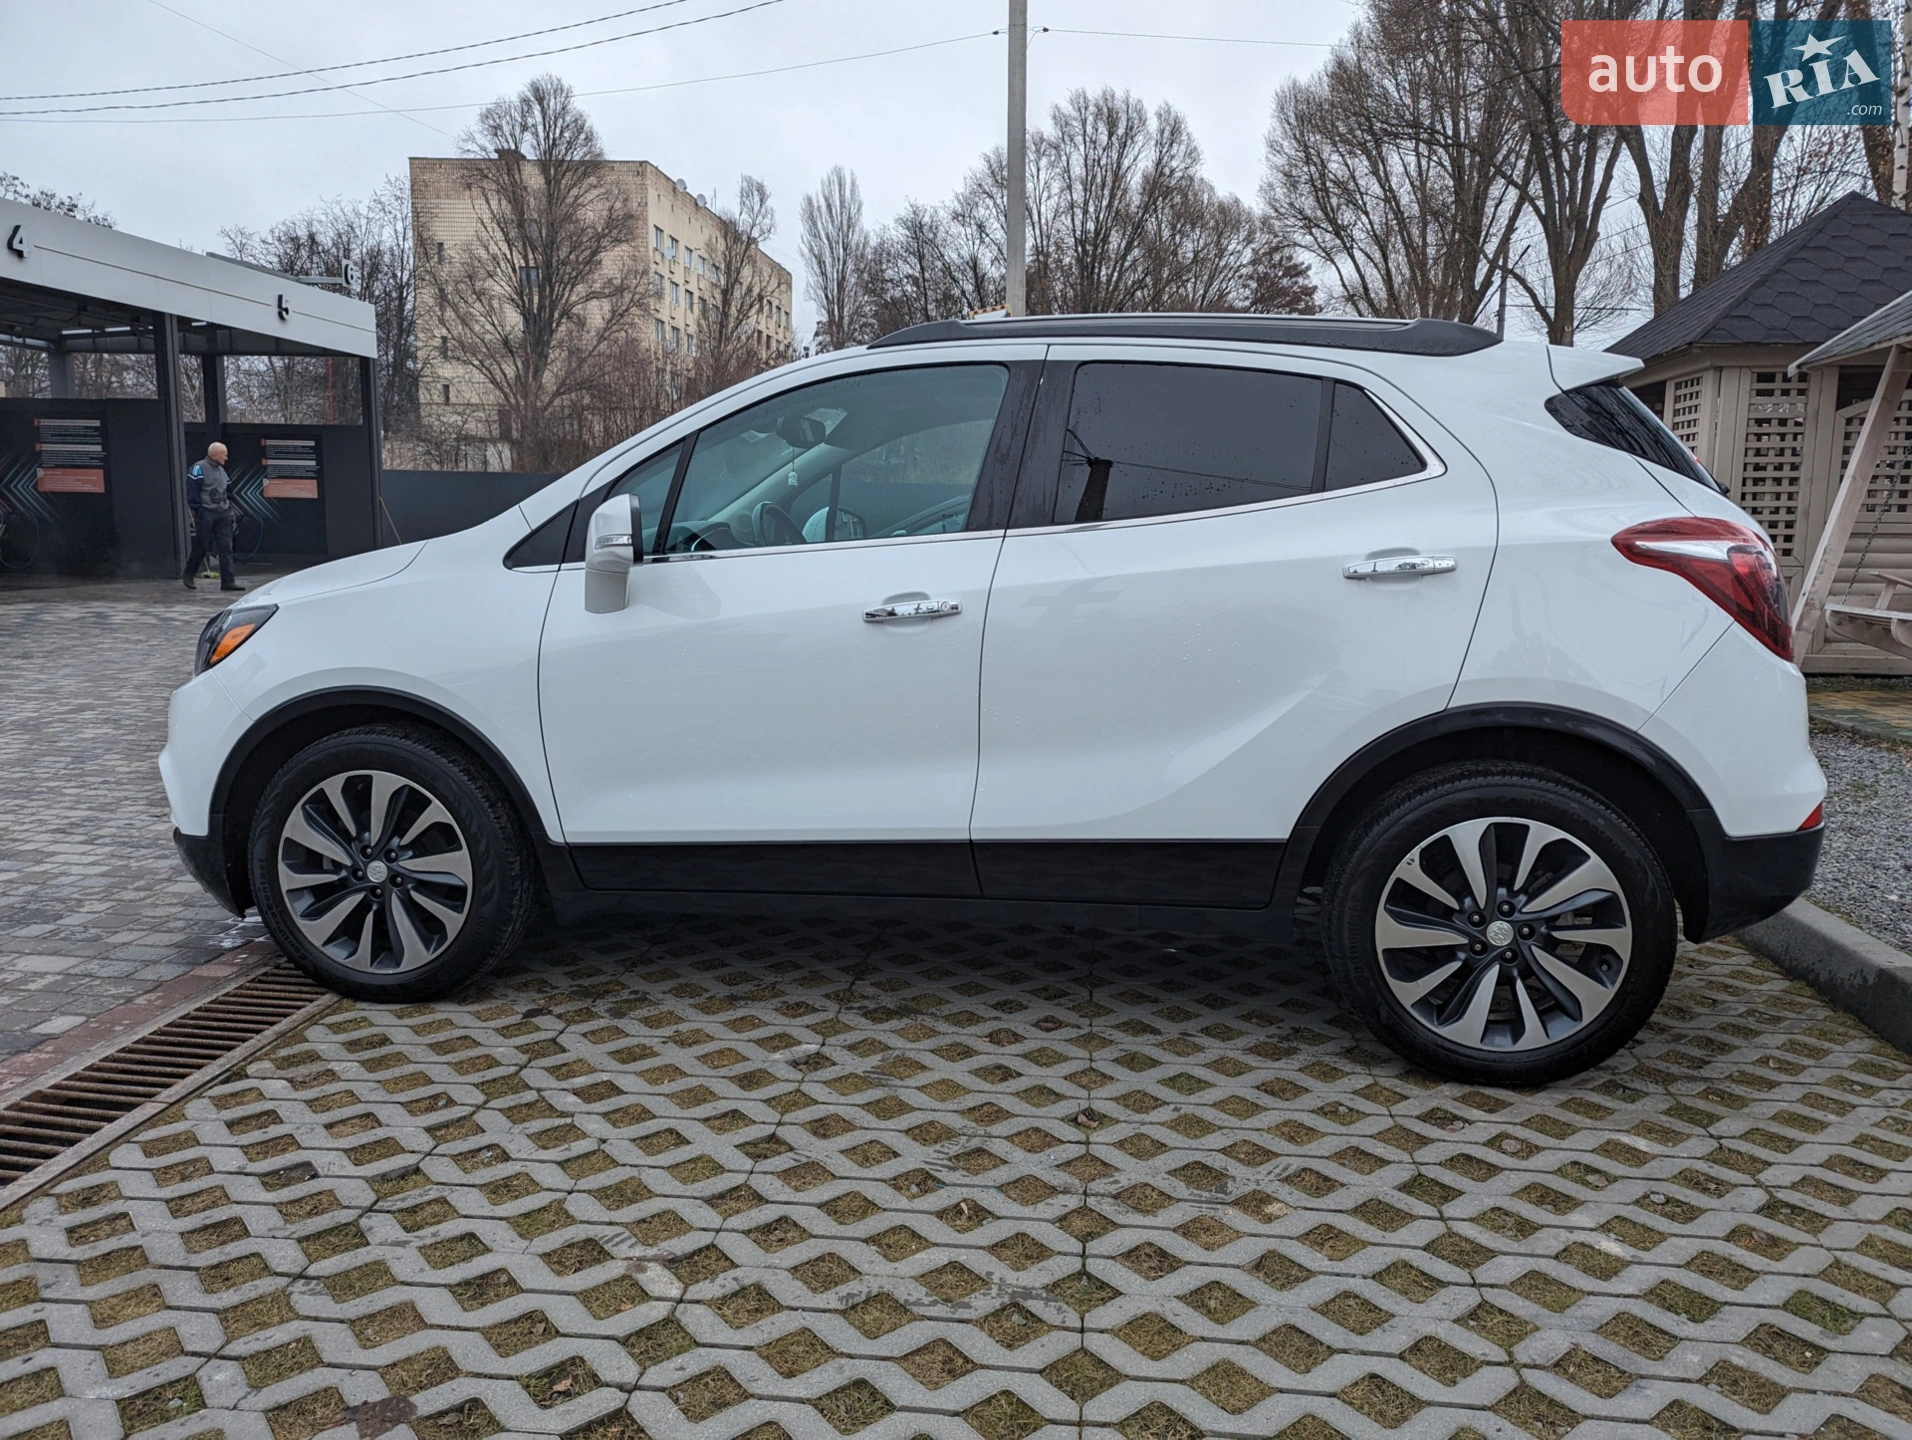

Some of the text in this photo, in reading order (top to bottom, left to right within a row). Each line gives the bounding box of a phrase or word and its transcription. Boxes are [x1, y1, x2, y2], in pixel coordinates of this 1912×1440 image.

[7, 224, 31, 259] 4
[343, 262, 357, 286] 6
[277, 294, 291, 321] 5
